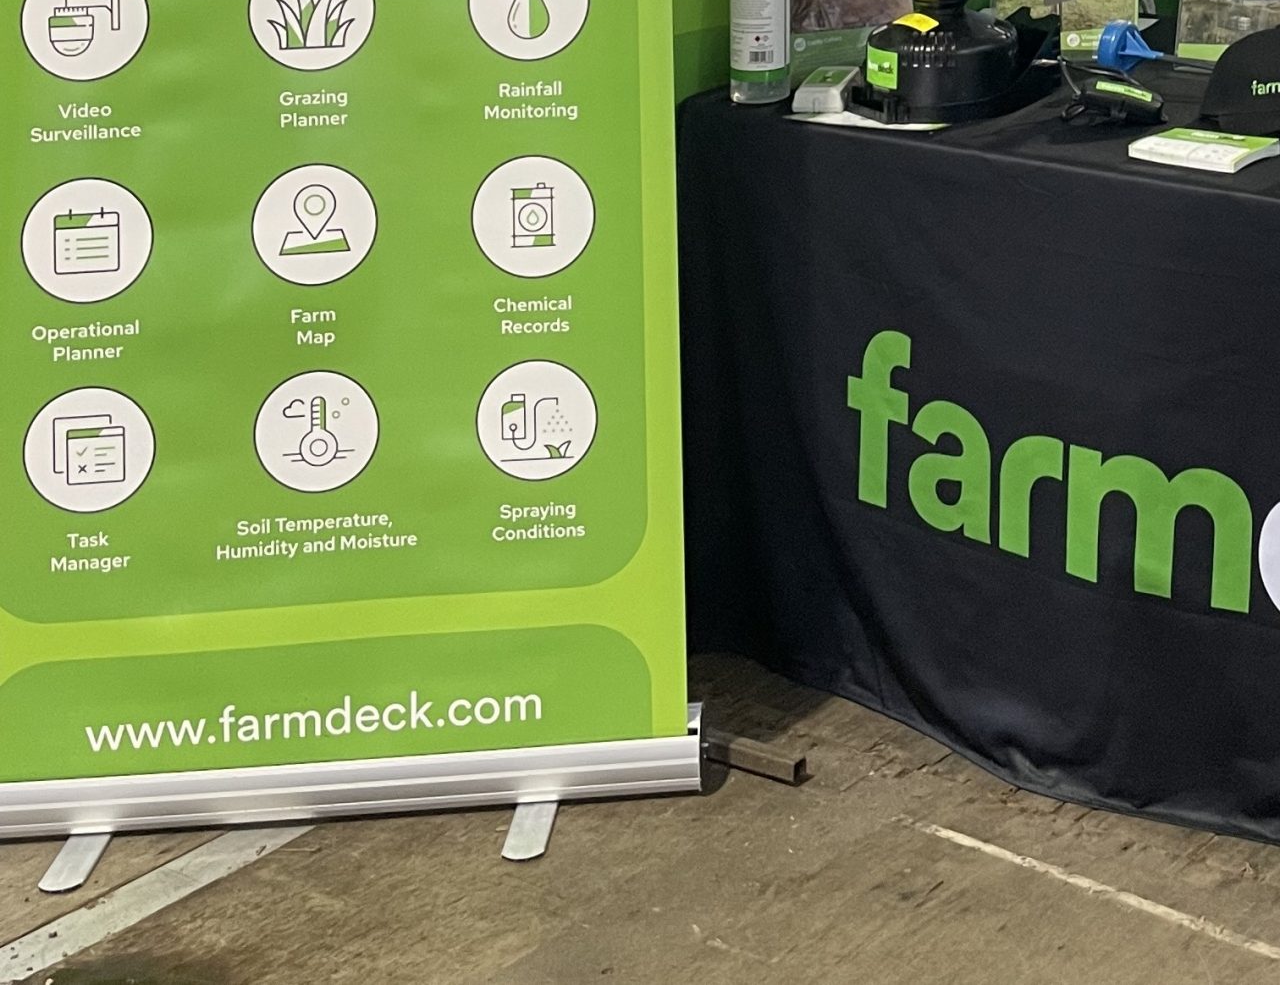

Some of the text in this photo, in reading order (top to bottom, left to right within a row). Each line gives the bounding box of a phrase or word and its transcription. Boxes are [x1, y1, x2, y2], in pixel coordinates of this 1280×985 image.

[499, 81, 561, 97] Rainfall
[280, 90, 347, 106] Grazing
[59, 103, 111, 118] Video
[485, 103, 577, 120] Monitoring
[281, 113, 347, 127] Planner
[31, 125, 141, 142] Surveillance
[494, 296, 571, 312] Chemical
[291, 309, 335, 323] Farm
[32, 320, 139, 343] Operational
[502, 318, 569, 334] Records
[297, 331, 335, 346] Map
[53, 344, 123, 361] Planner
[500, 502, 575, 525] Spraying
[238, 514, 392, 537] Soil Temperature,
[492, 519, 585, 541] Conditions
[67, 532, 108, 548] Task
[217, 533, 417, 559] Humidity and Moisture
[51, 556, 130, 572] Manager
[85, 691, 543, 752] www.farmdeck.com
